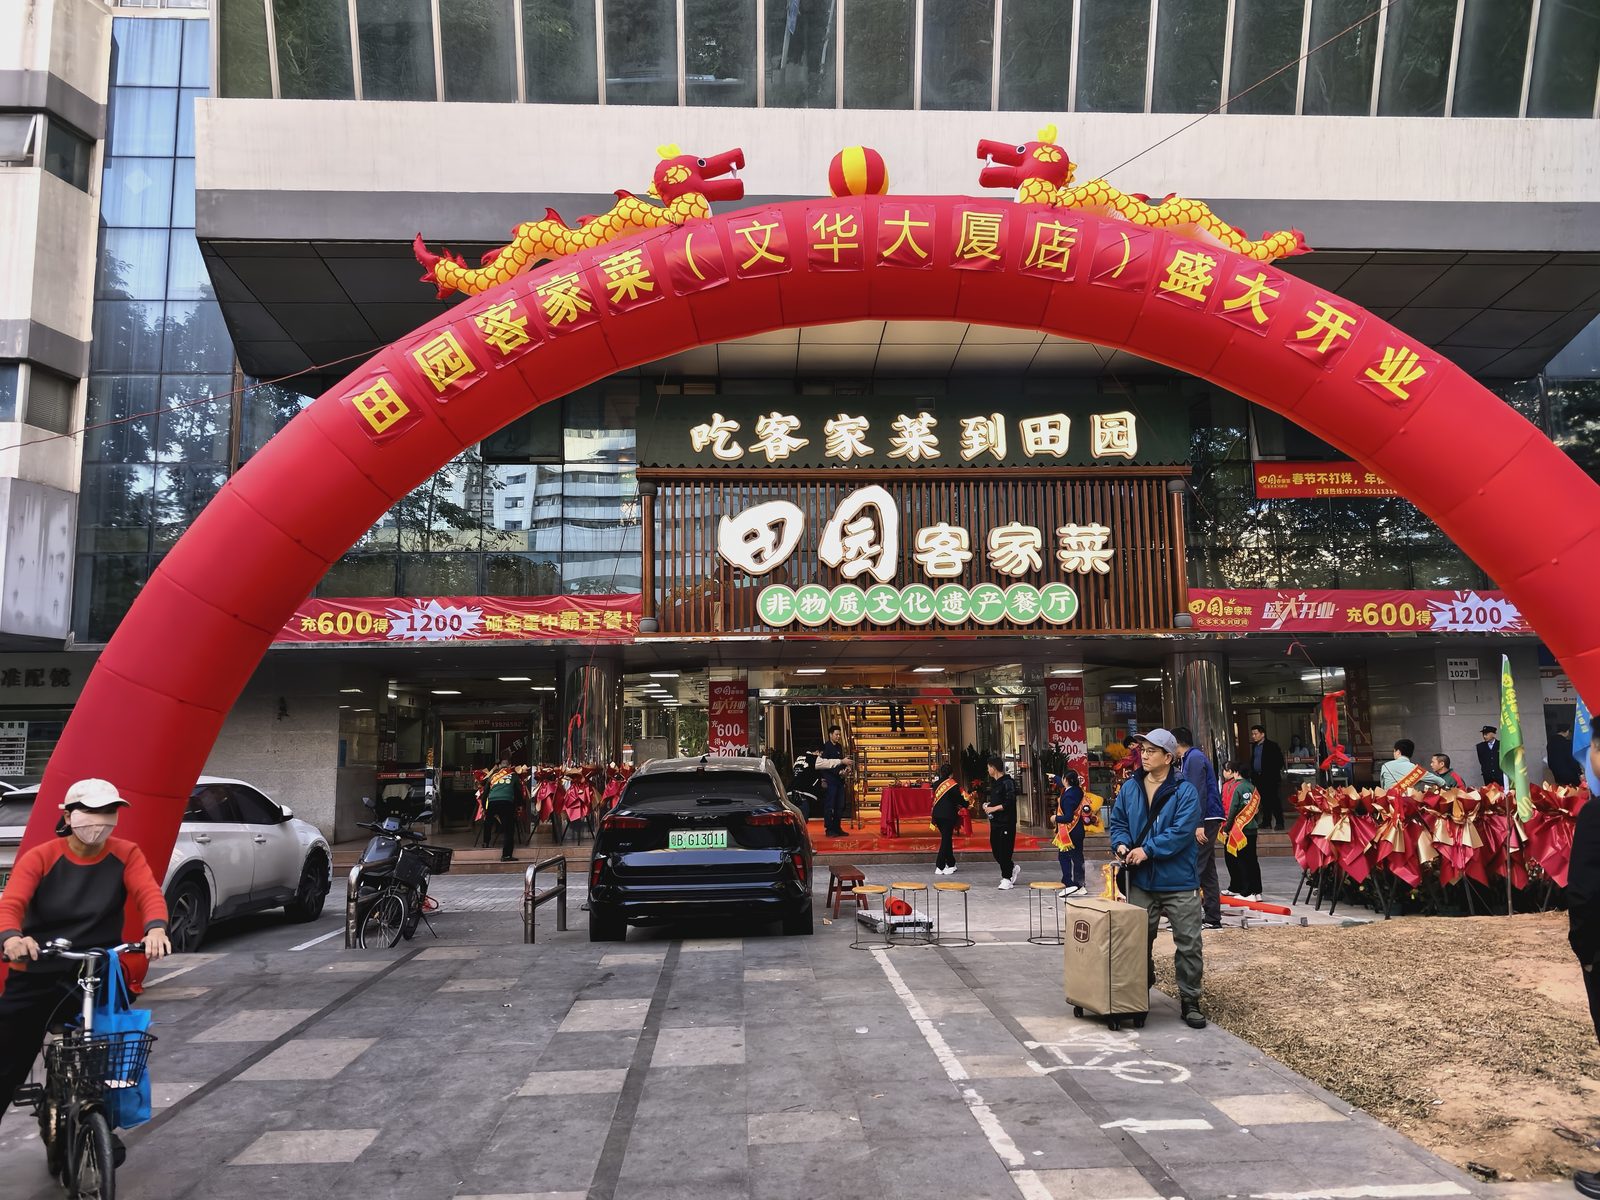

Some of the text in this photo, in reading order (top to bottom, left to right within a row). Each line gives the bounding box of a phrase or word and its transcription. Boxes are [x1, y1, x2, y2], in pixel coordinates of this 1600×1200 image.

[690, 411, 1138, 461] 吃客家菜到田园
[717, 484, 1114, 582] 田园客家菜
[763, 589, 1075, 617] 非物质文化遗产餐厅
[1450, 670, 1469, 678] 1027
